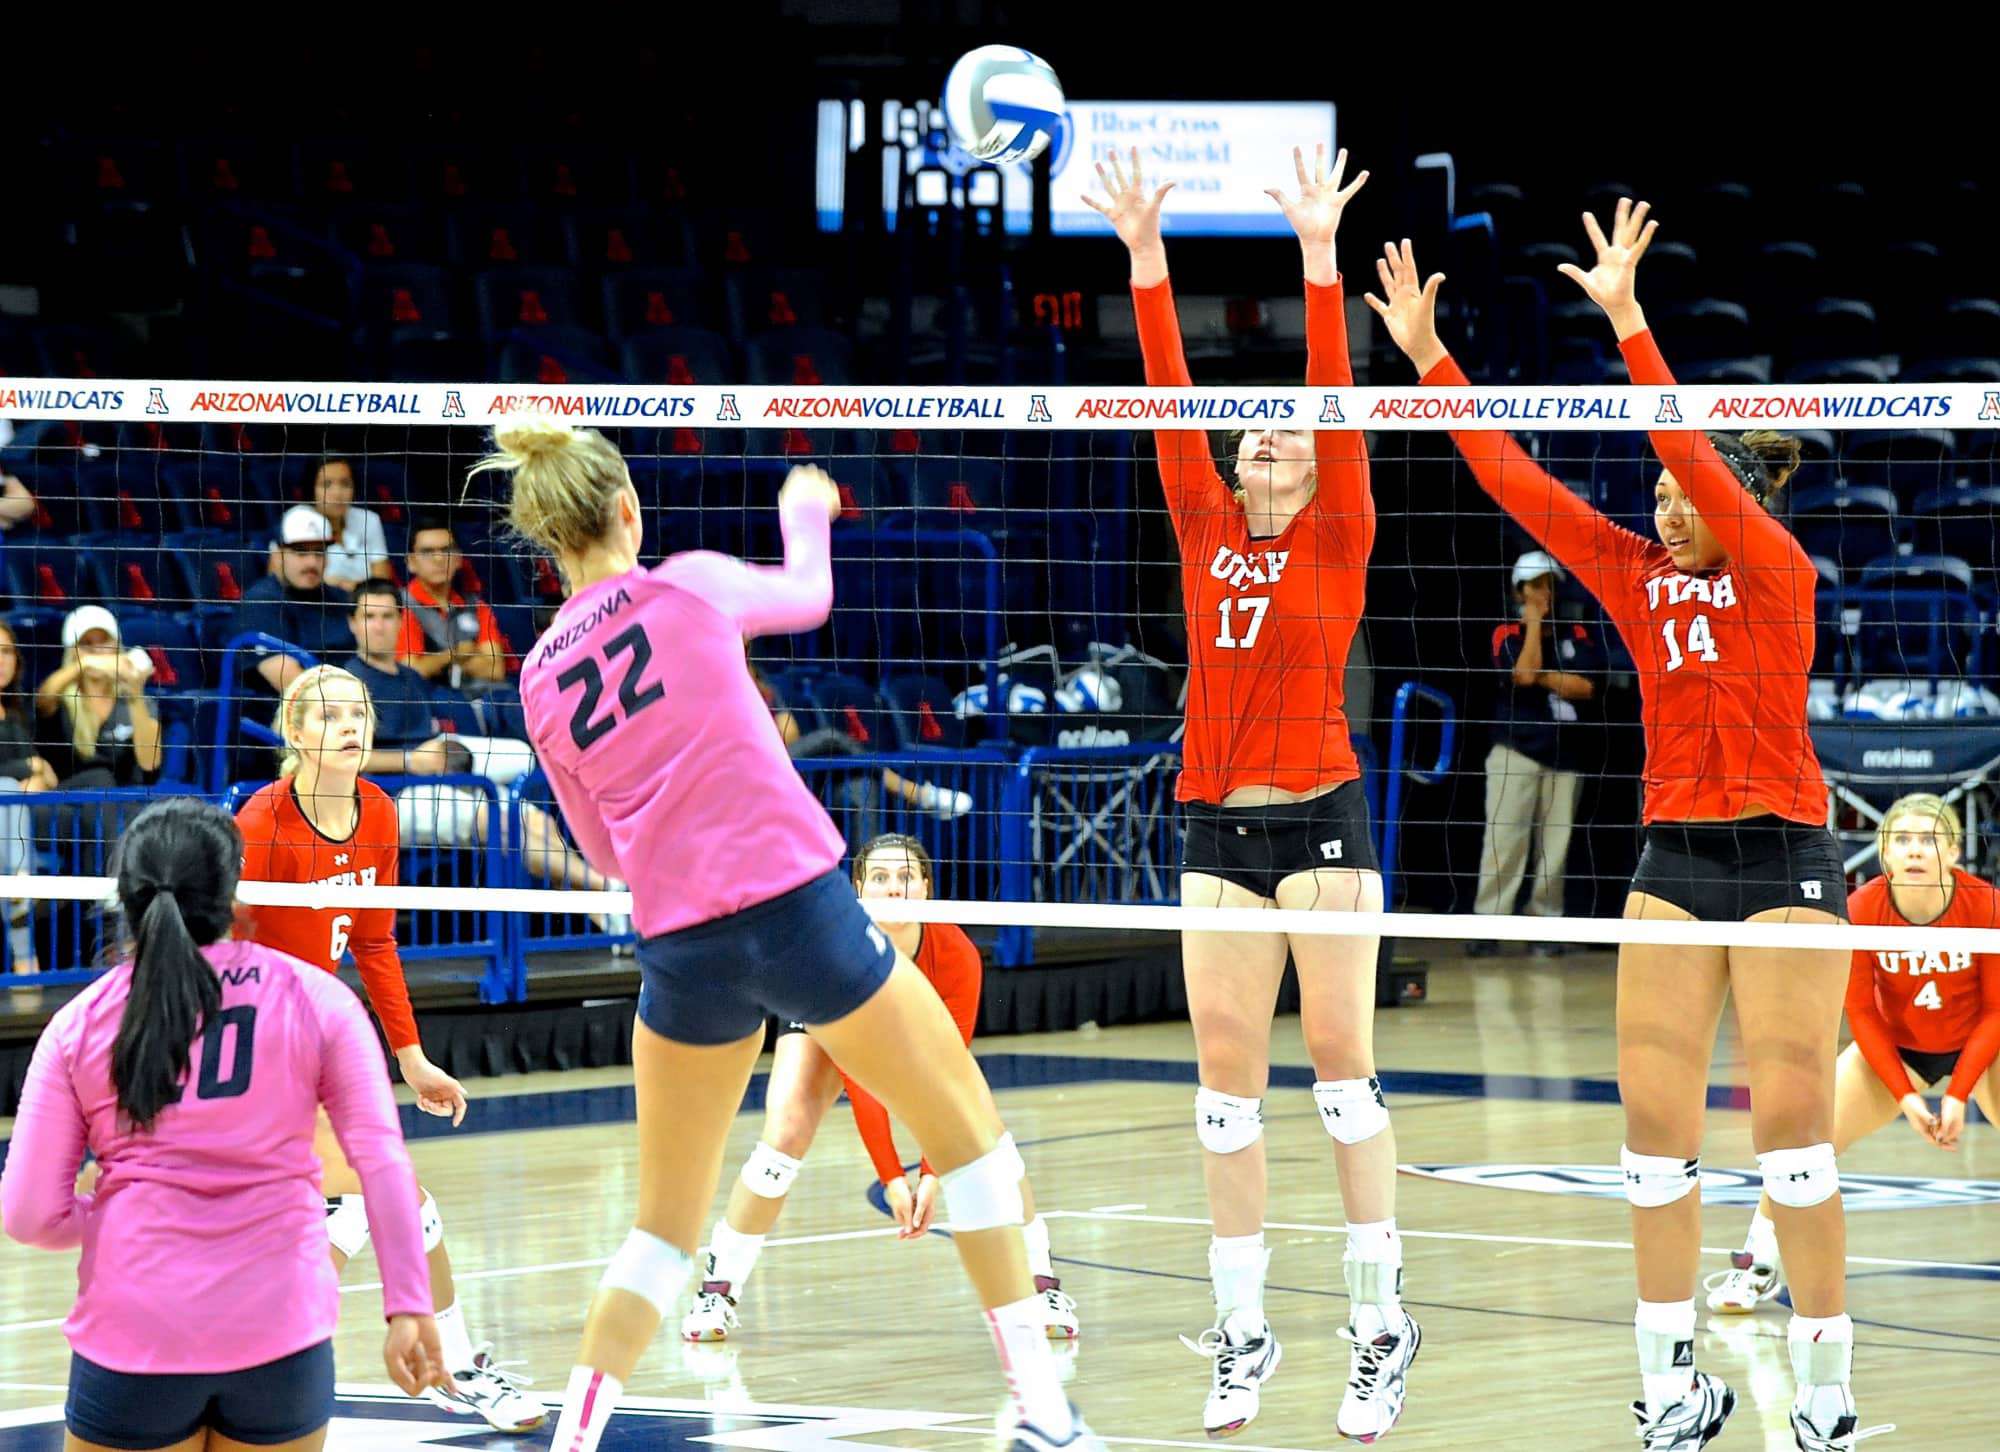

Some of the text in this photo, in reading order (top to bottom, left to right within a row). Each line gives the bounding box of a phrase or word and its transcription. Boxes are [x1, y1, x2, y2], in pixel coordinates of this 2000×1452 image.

[1644, 573, 1737, 612] UTAH
[538, 588, 632, 668] ARIZONA
[1215, 597, 1271, 649] 17
[1661, 614, 1719, 673] 14
[556, 622, 666, 752] 22
[1862, 747, 1934, 769] molten
[329, 913, 353, 961] 6
[1876, 950, 1971, 977] UTAH
[1913, 980, 1943, 1011] 4
